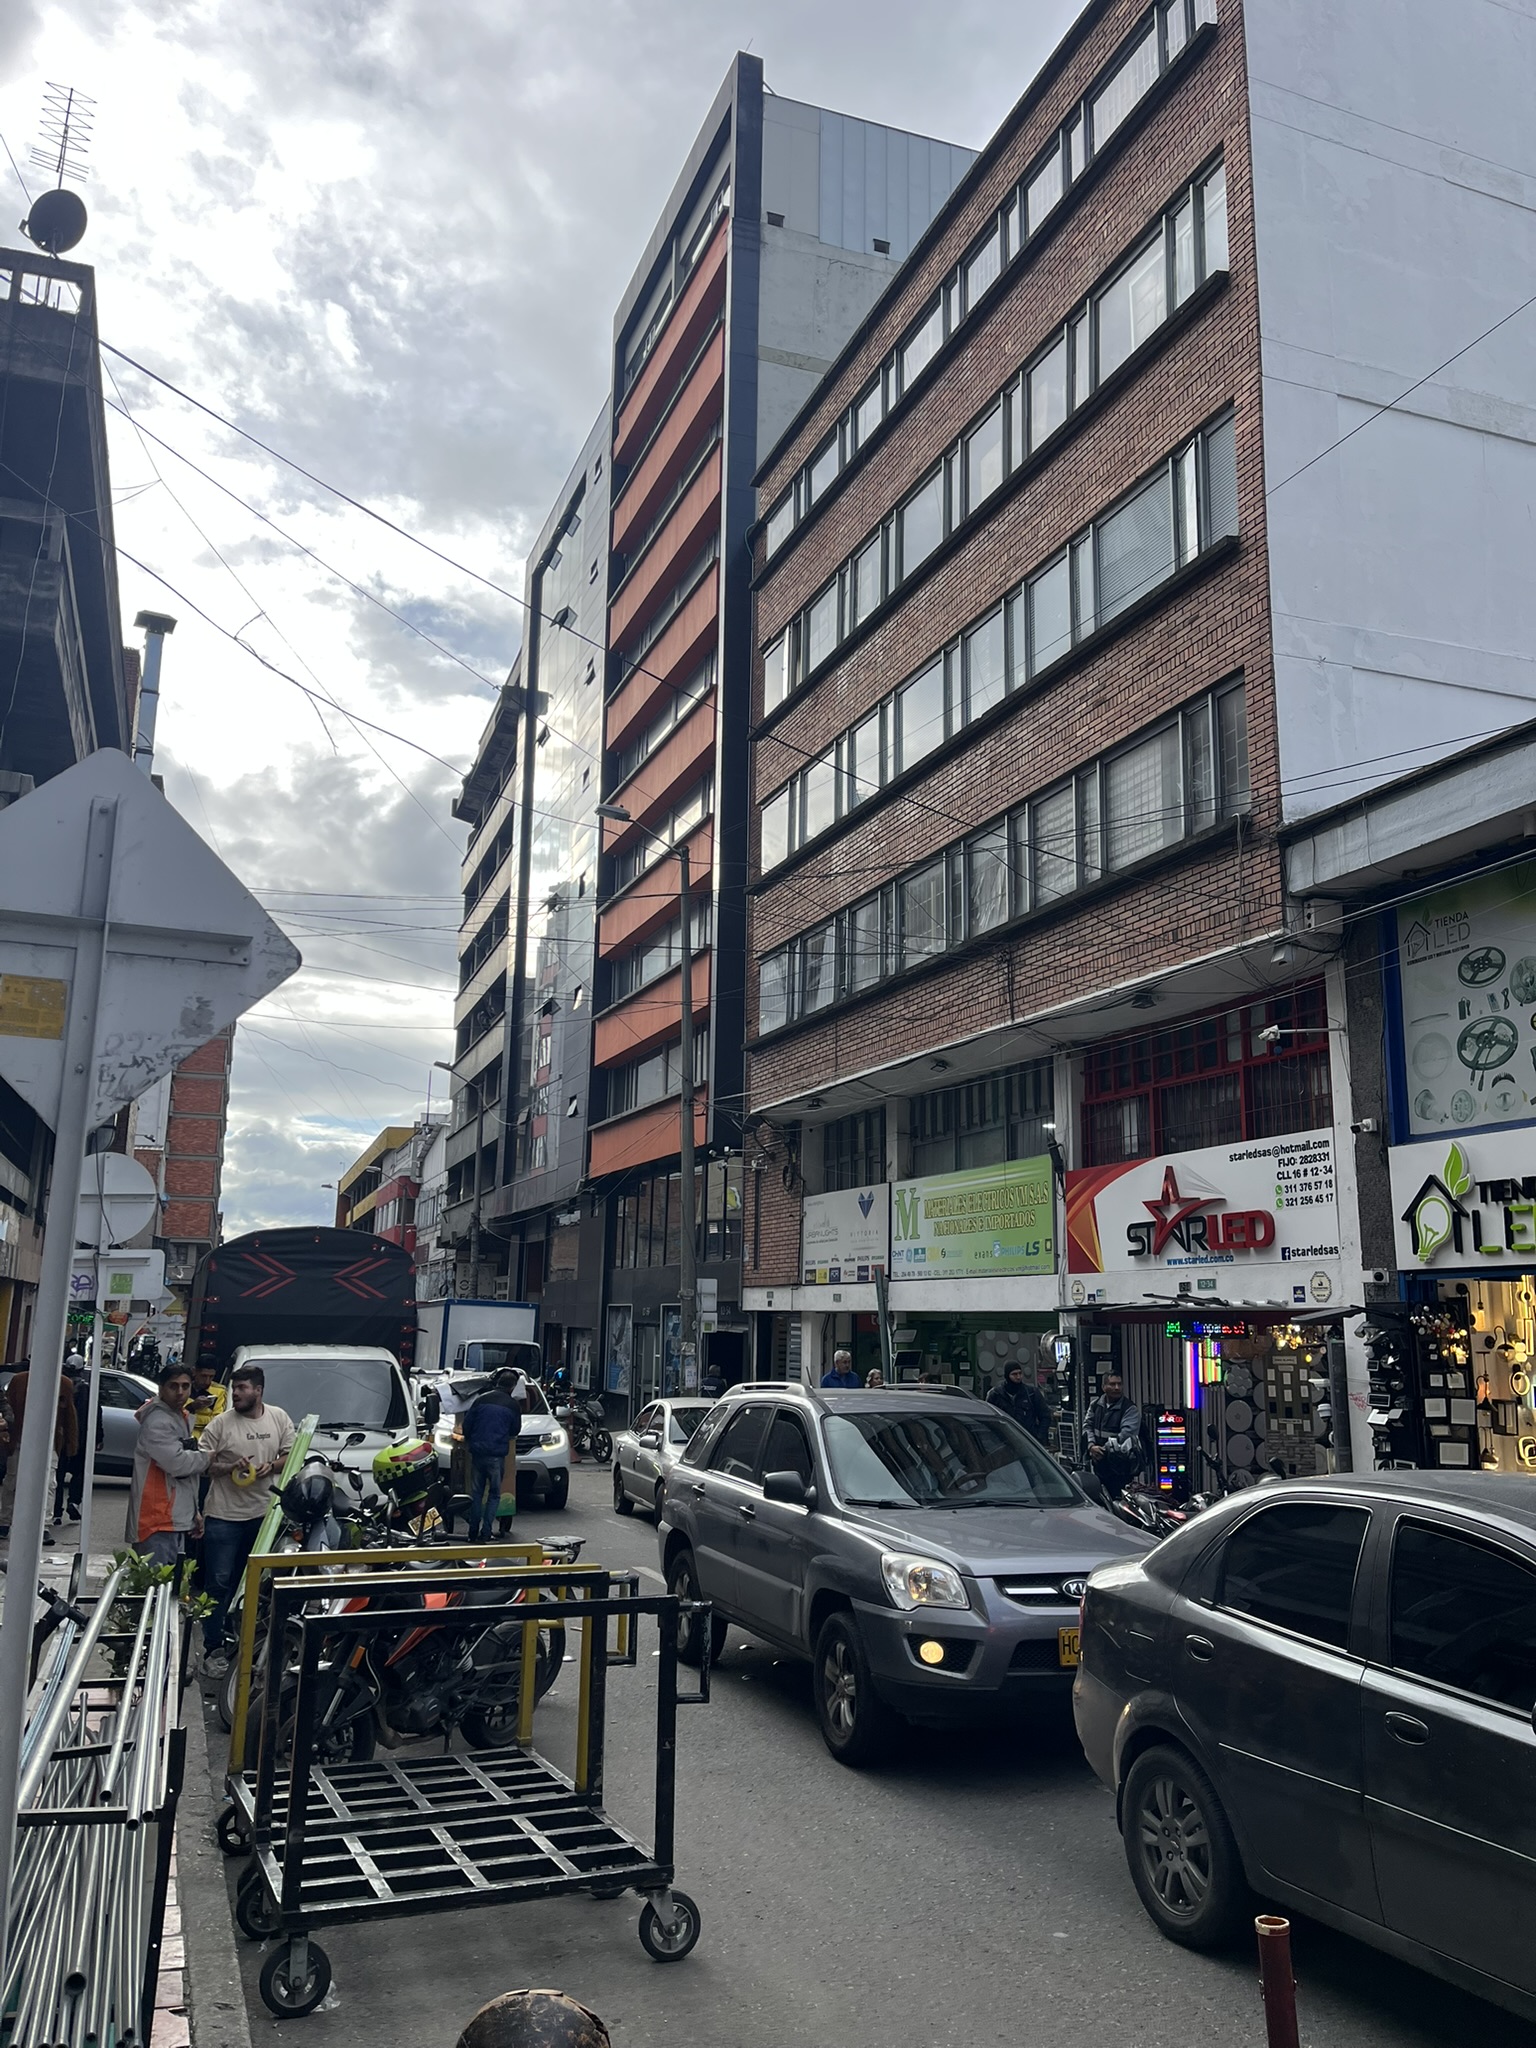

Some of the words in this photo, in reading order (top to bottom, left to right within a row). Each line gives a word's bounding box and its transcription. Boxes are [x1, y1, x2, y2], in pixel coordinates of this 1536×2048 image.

[1435, 911, 1469, 928] TIENDA
[1433, 922, 1470, 949] LED
[1229, 1140, 1330, 1162] starledsas@hotmail.com
[1278, 1157, 1298, 1168] FIJO:
[1299, 1152, 1330, 1165] 2828331
[1276, 1171, 1291, 1181] CLL
[1292, 1169, 1302, 1178] 16
[1284, 1184, 1297, 1194] 311
[1299, 1182, 1312, 1192] 376
[1314, 1181, 1323, 1190] 57
[1324, 1179, 1333, 1189] 18
[924, 1195, 967, 1219] MATERIALES
[967, 1187, 1014, 1214] ELECTRICOS
[1285, 1197, 1298, 1207] 321
[1300, 1196, 1313, 1206] 256
[1315, 1194, 1324, 1204] 45
[1325, 1193, 1334, 1202] 17
[933, 1217, 977, 1237] NACIONALES
[978, 1215, 984, 1232] E
[985, 1210, 1036, 1231] IMPORTADOS
[1471, 1204, 1536, 1252] LE
[1026, 1241, 1040, 1256] LS
[1291, 1245, 1339, 1258] starledsas
[1167, 1254, 1234, 1266] www.starled.com.co
